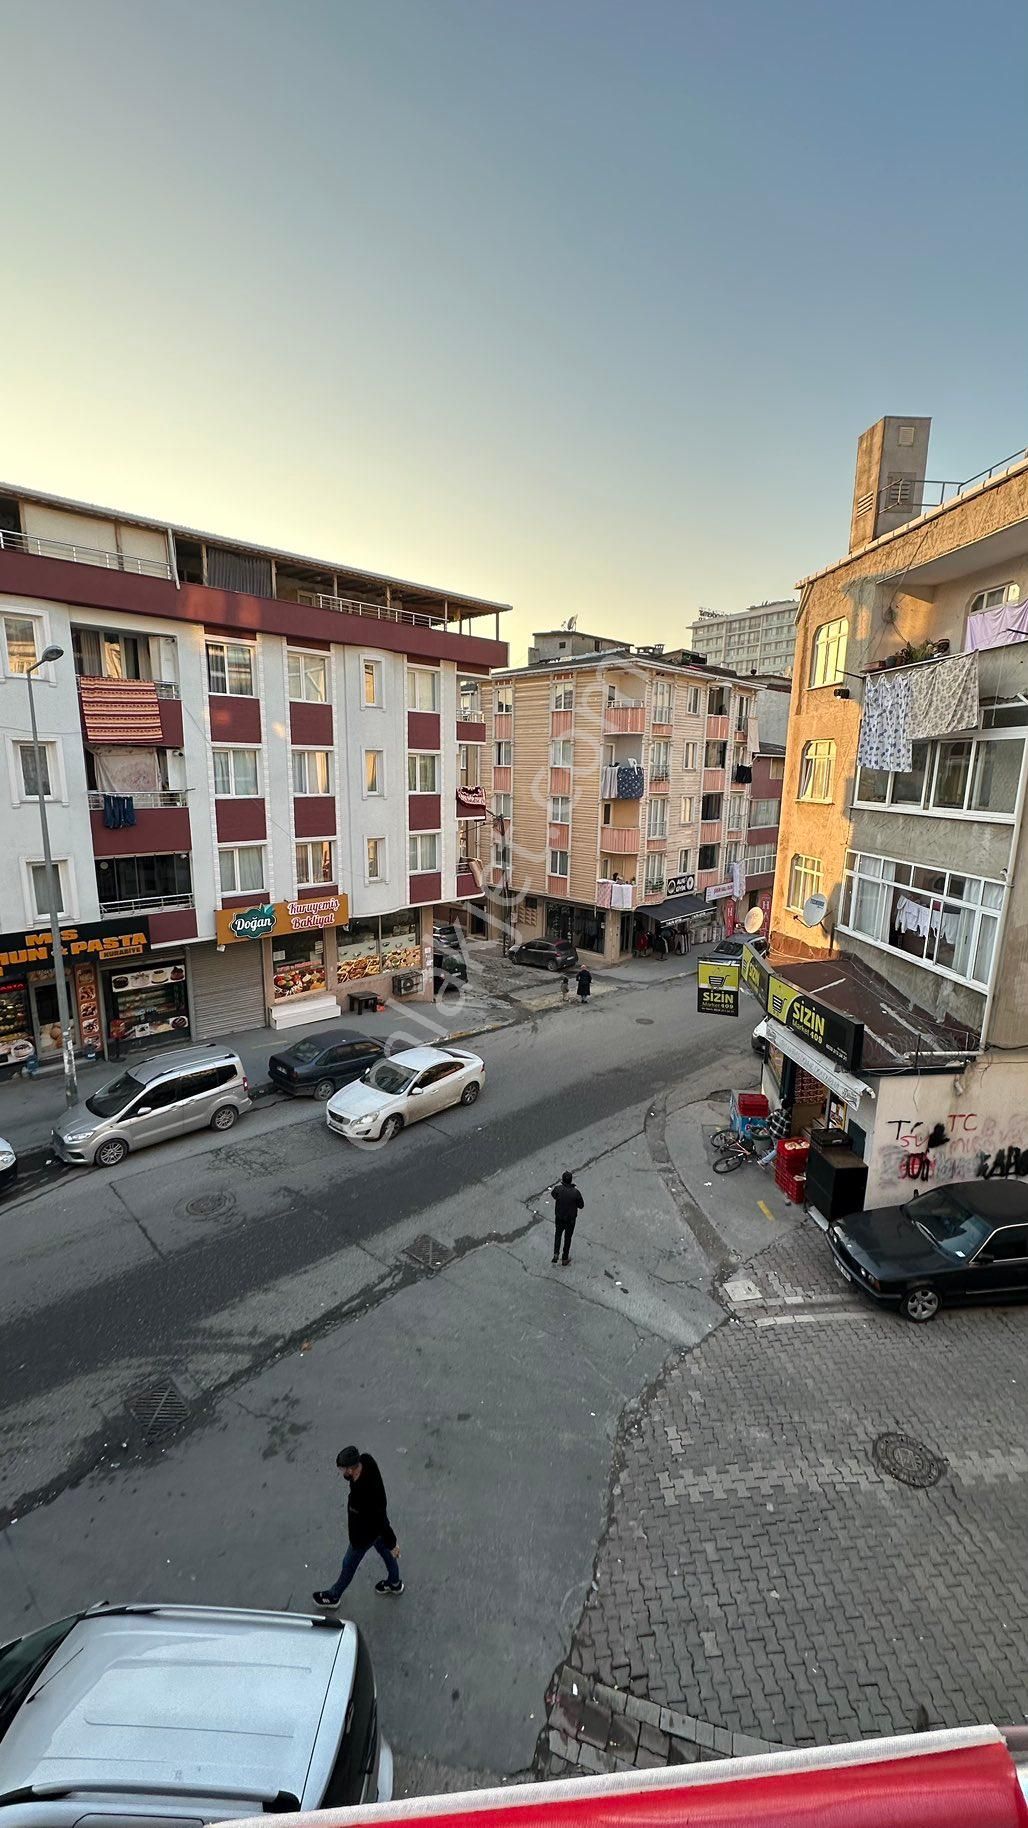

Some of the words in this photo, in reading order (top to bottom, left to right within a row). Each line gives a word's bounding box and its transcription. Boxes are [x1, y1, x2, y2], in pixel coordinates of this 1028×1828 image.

[287, 897, 340, 915] Kuruyemiş
[234, 916, 272, 931] Doğan
[291, 913, 335, 929] Bakliyat
[25, 929, 79, 947] MS
[70, 932, 147, 955] PASTA
[702, 990, 734, 1004] SİZİN
[792, 1000, 826, 1036] SİZİN
[948, 1114, 977, 1132] TC
